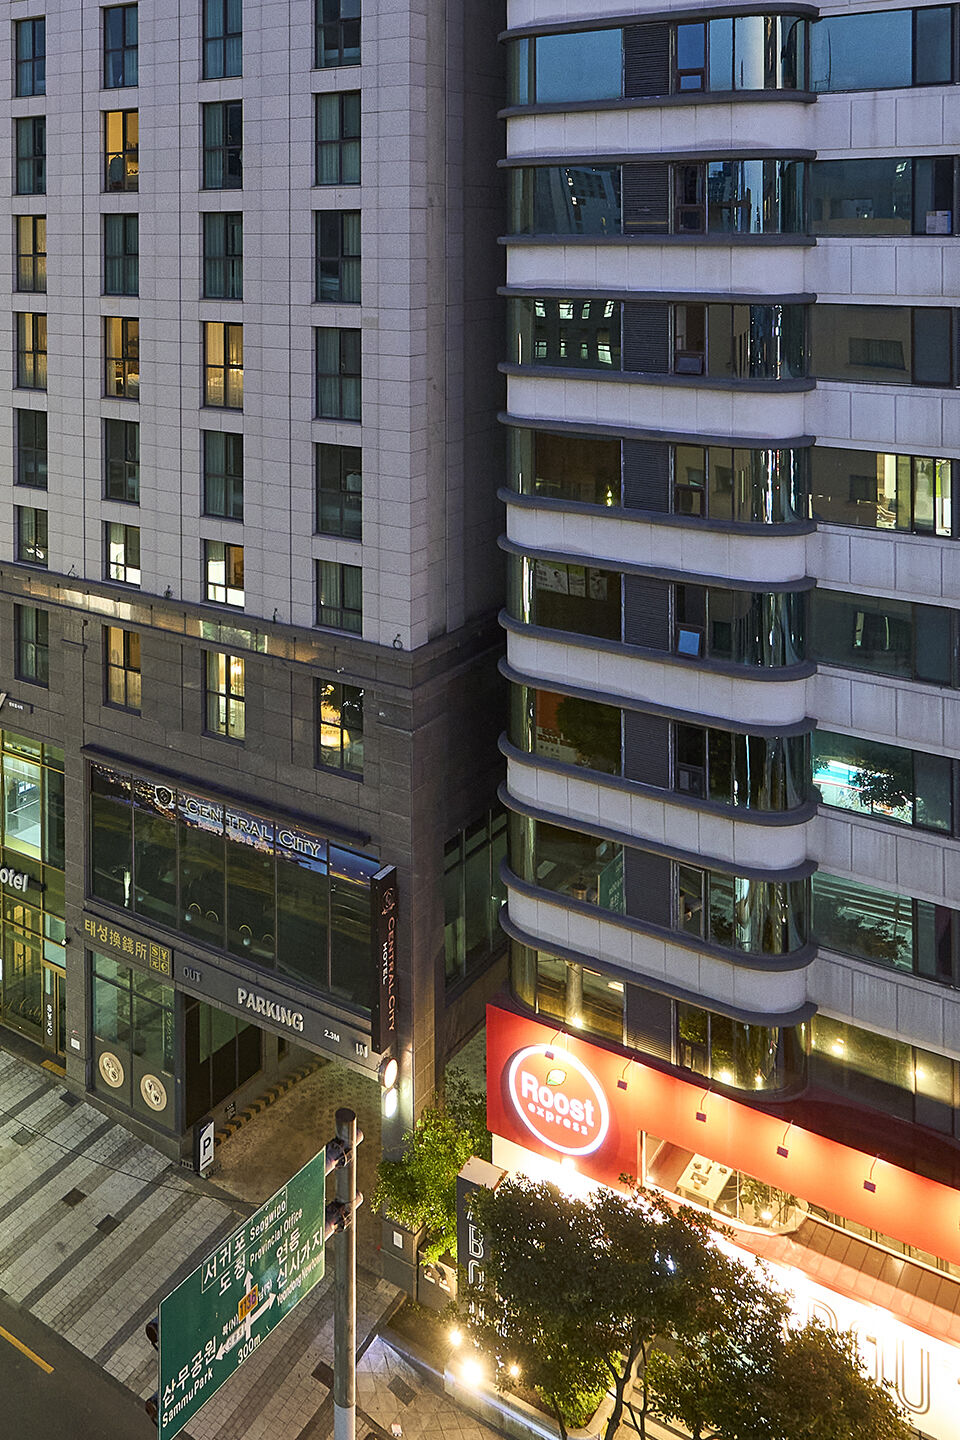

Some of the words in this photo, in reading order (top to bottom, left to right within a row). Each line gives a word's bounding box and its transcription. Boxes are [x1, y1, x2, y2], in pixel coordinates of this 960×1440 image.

[183, 966, 201, 982] OUT
[388, 916, 397, 994] CENTRAL
[237, 987, 305, 1033] PARKING
[388, 996, 396, 1031] CITY
[324, 1029, 340, 1043] 2.3M
[355, 1042, 369, 1059] IN
[521, 1070, 595, 1128] Roost
[527, 1102, 588, 1136] express
[202, 1136, 212, 1156] P
[204, 1229, 246, 1284] 서귀포
[250, 1200, 286, 1241] Seogwipo
[219, 1254, 246, 1296] 도청
[250, 1225, 283, 1267] Provincial
[283, 1208, 303, 1232] Office
[276, 1227, 301, 1265] 연동
[277, 1226, 323, 1289] 신시가지
[238, 1333, 261, 1364] 300m
[162, 1335, 216, 1409] 삼무공원
[162, 1388, 194, 1428] Sammu
[194, 1367, 213, 1396] Park
